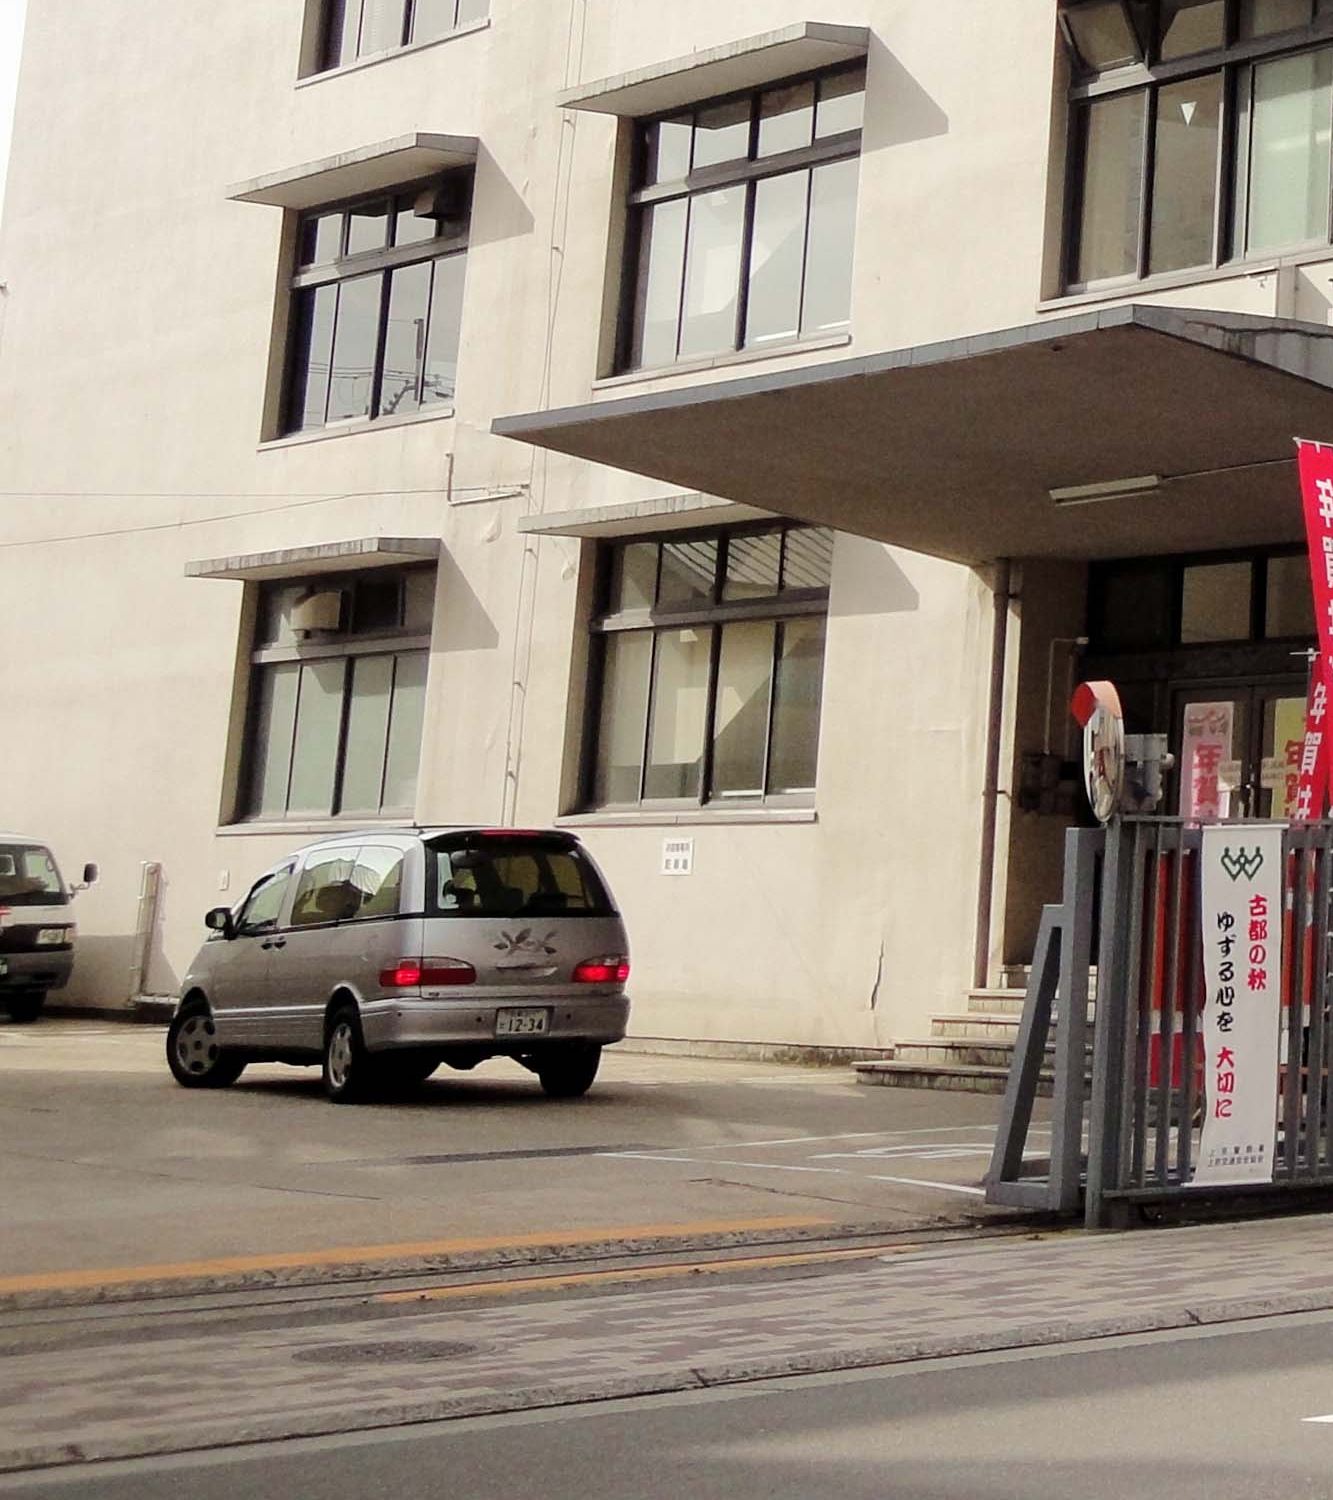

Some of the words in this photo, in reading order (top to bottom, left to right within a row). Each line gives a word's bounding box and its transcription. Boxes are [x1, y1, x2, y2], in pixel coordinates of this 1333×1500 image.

[1215, 911, 1236, 1033] ゆずる心を
[1247, 894, 1268, 990] 古都の秋
[1215, 1046, 1235, 1118] 大切に
